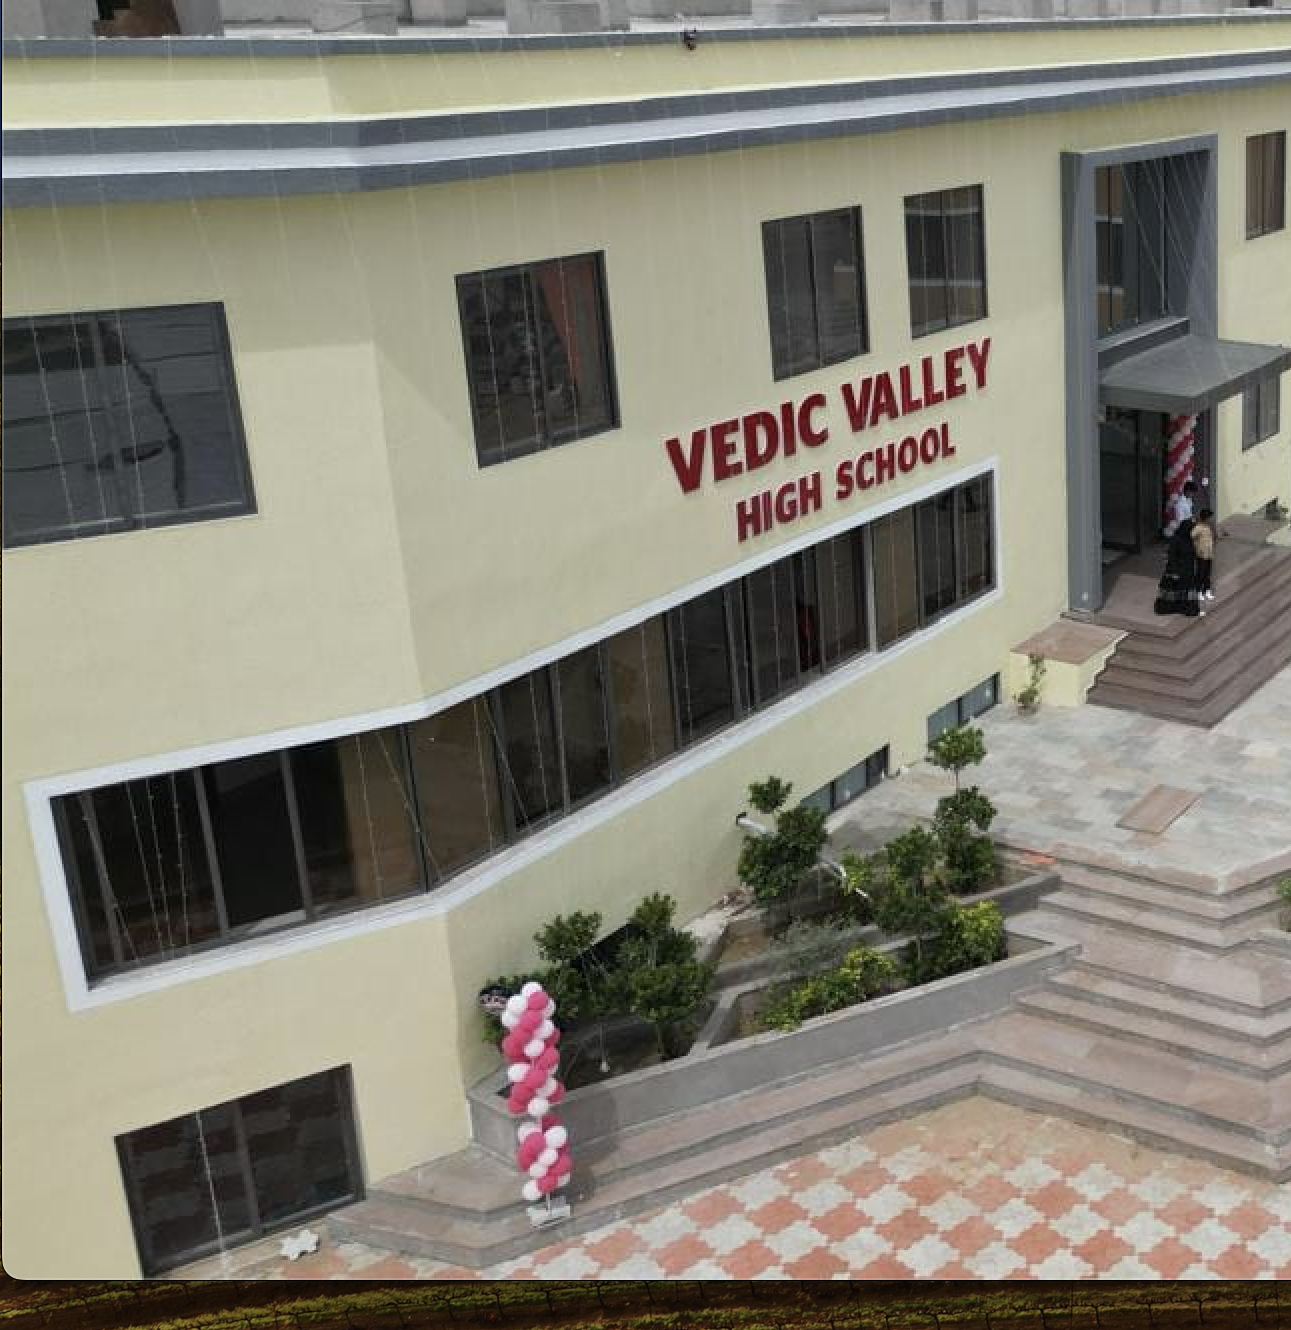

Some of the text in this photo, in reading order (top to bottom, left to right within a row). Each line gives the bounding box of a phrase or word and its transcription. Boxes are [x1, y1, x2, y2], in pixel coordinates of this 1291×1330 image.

[665, 337, 991, 494] VEDIC VALLEY
[737, 422, 955, 542] HIGH SCHOOL
